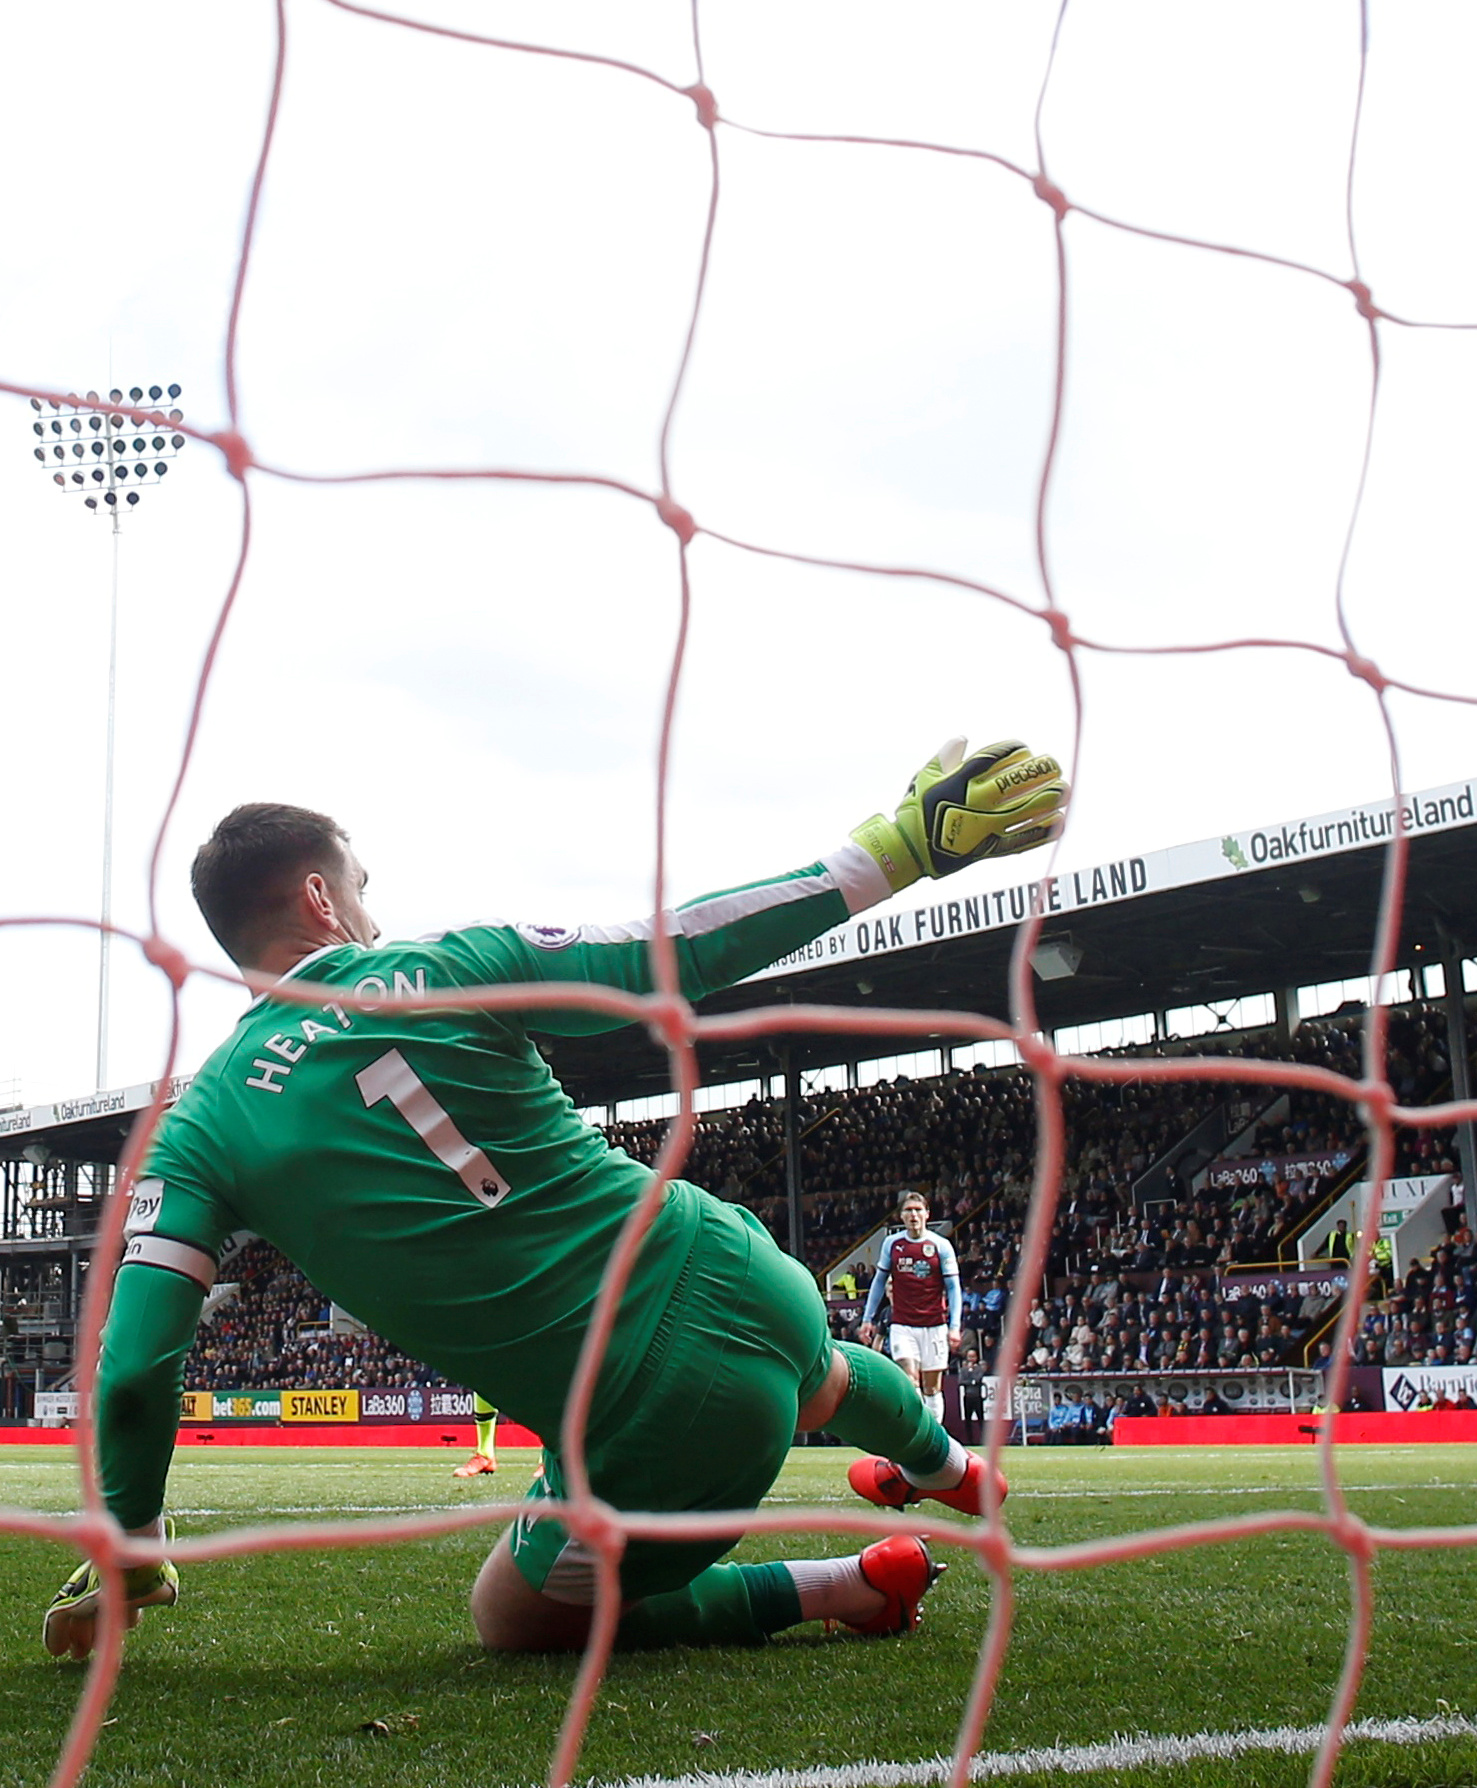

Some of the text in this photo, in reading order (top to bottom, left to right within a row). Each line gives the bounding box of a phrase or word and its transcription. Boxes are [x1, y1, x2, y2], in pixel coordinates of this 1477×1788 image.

[994, 757, 1058, 792] precision
[1250, 785, 1474, 863] Oakfurnitureland
[829, 934, 846, 955] BY
[856, 914, 904, 955] OAK
[914, 878, 1061, 941] FURNITURE
[1073, 858, 1148, 904] LAND
[60, 1091, 125, 1121] Oakfurnitureland
[354, 1048, 511, 1209] 1
[212, 1396, 281, 1417] bet365.com
[290, 1396, 348, 1417] STANLEY
[362, 1394, 406, 1416] LaBa360
